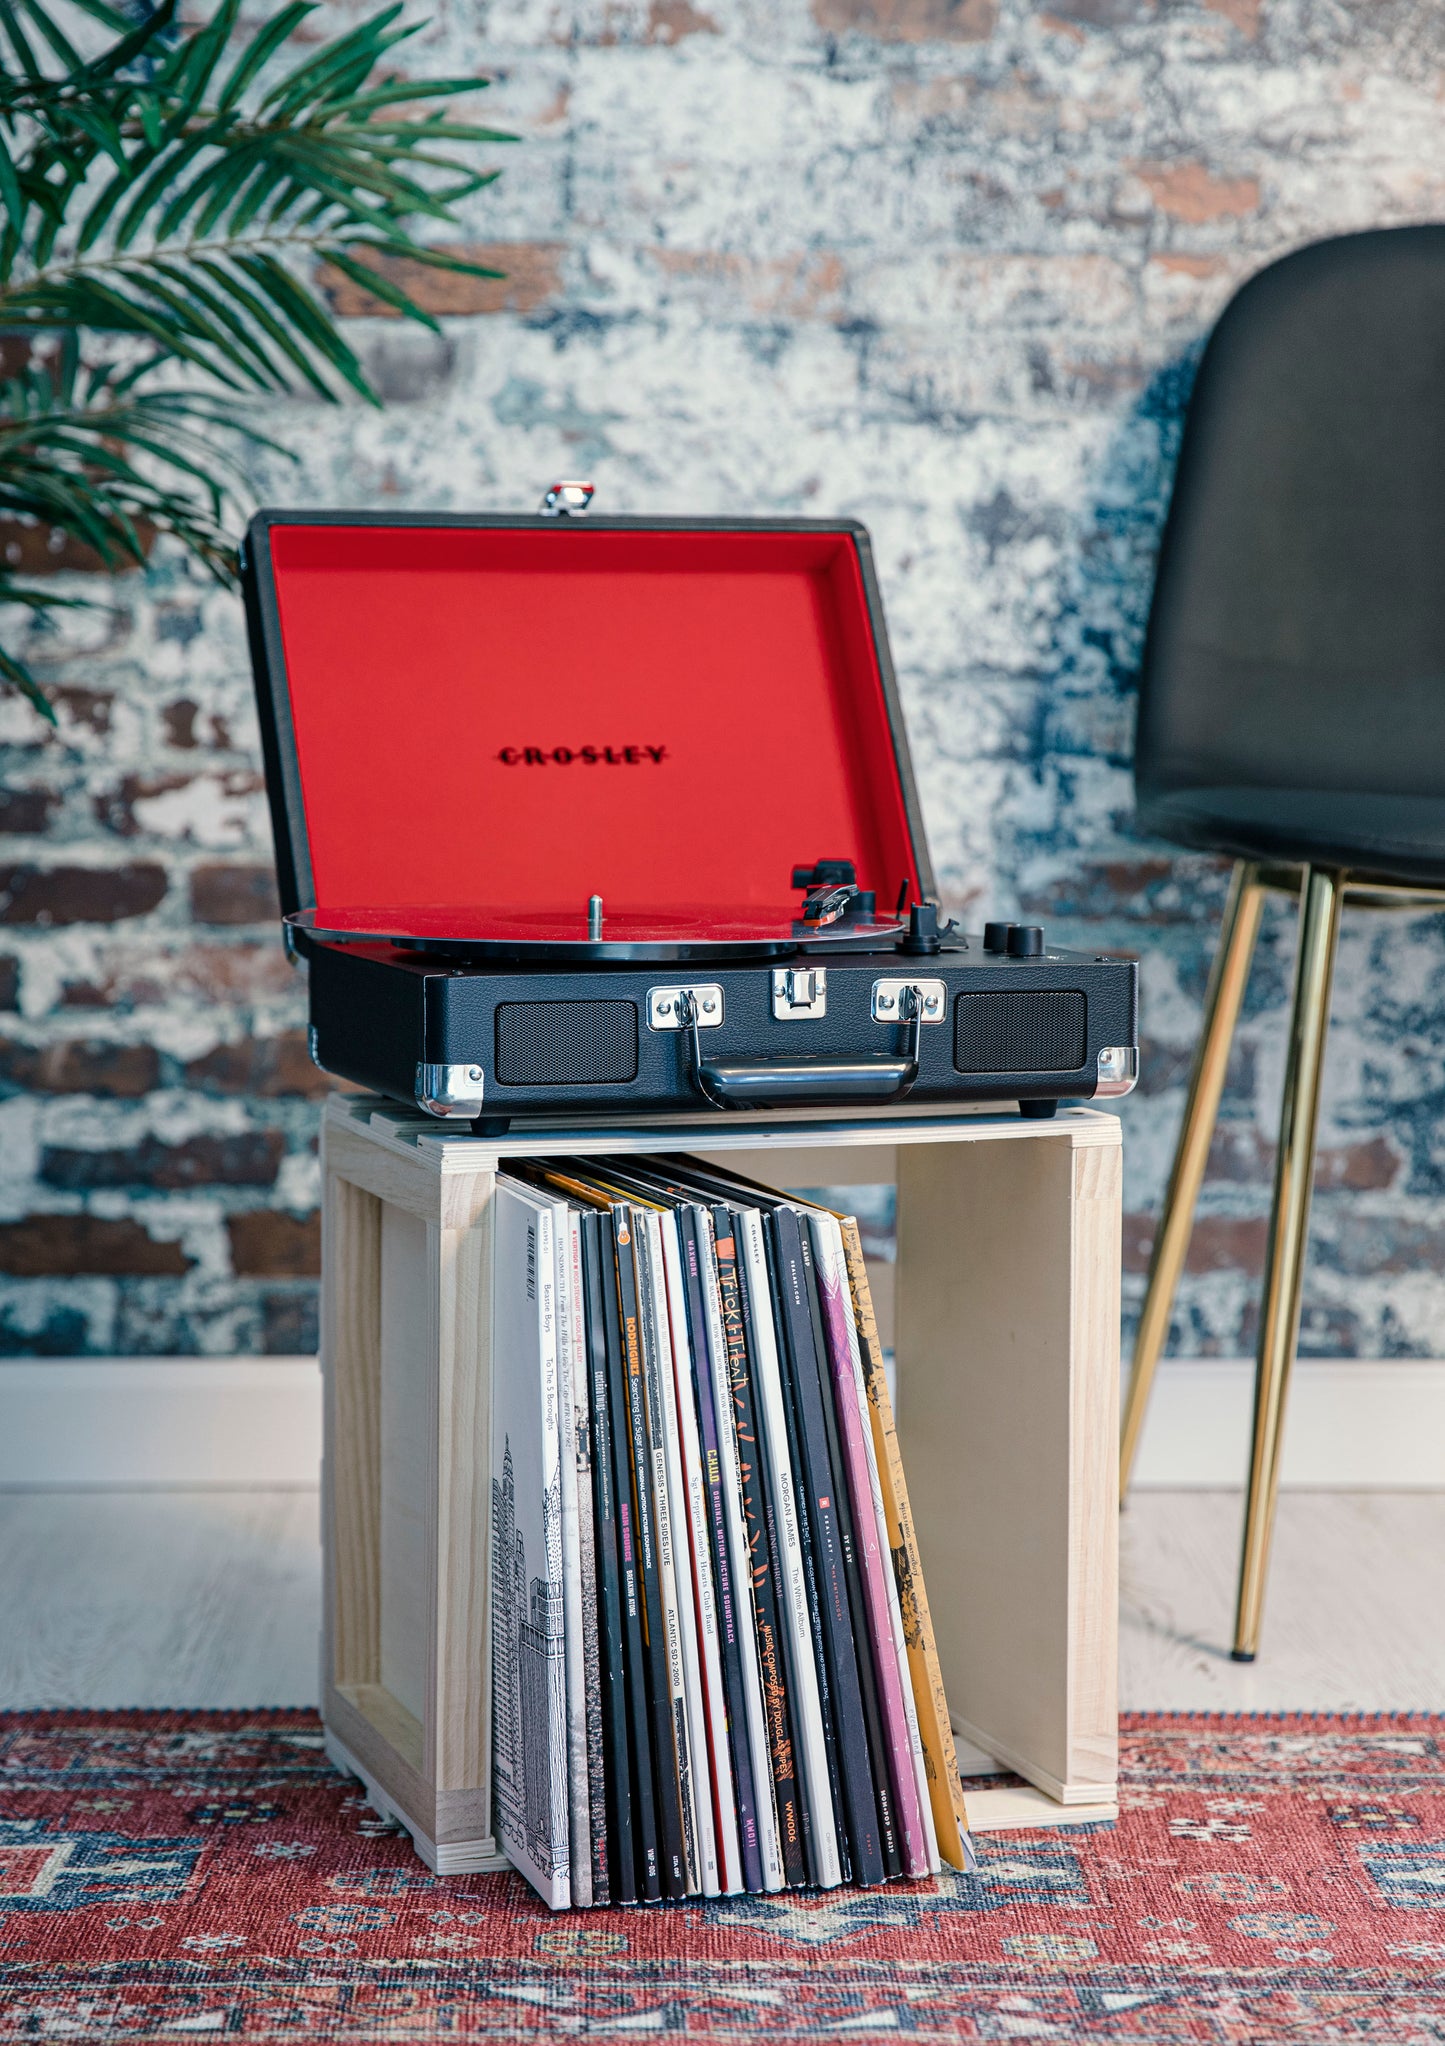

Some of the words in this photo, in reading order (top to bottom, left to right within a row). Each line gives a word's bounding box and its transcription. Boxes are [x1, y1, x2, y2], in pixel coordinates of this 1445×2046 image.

[499, 745, 666, 766] CROSLEY
[751, 1223, 760, 1264] CROSLEY
[802, 1240, 810, 1267] CAAMP
[687, 1239, 697, 1277] WAXWORK
[721, 1267, 740, 1322] Trick
[738, 1266, 747, 1298] NIGHT
[790, 1260, 800, 1305] REALART.COM
[626, 1317, 640, 1377] RODRIGUEZ
[728, 1332, 749, 1385] Treat
[546, 1357, 553, 1367] To
[631, 1378, 641, 1413] Searching
[546, 1393, 554, 1430] Boroughs
[634, 1414, 642, 1426] For
[634, 1426, 644, 1447] Sugar
[637, 1448, 645, 1464] Man
[655, 1452, 665, 1487] GENESIS
[707, 1449, 719, 1485] C.H.U.D.
[712, 1490, 723, 1526] ORIGINAL
[780, 1472, 793, 1516] MORGAN
[621, 1503, 630, 1526] MAIN
[659, 1495, 668, 1523] THREE
[900, 1502, 908, 1520] WELLS
[661, 1523, 670, 1547] SIDES
[696, 1530, 706, 1558] Lonely
[716, 1529, 727, 1557] MOTION
[766, 1505, 779, 1555] DANCING
[786, 1519, 796, 1548] JAMES
[622, 1527, 632, 1562] SOURCE
[644, 1535, 652, 1569] SOUNDTRACK
[663, 1549, 671, 1566] LIVE
[843, 1534, 850, 1544] BY
[847, 1553, 853, 1563] BY
[626, 1570, 635, 1597] BREAKING
[700, 1562, 709, 1588] Hearts
[719, 1560, 730, 1592] PICTURE
[772, 1556, 784, 1600] CHROME
[791, 1567, 801, 1584] The
[628, 1598, 636, 1617] ATOMS
[703, 1592, 712, 1612] Club
[794, 1586, 803, 1610] White
[833, 1582, 842, 1623] ANTHOLOGY
[668, 1609, 677, 1648] ATLANTIC
[705, 1615, 714, 1635] Band
[722, 1595, 736, 1644] SOUNDTRACK
[797, 1612, 807, 1639] Album
[763, 1625, 774, 1650] MUSIC
[671, 1650, 678, 1660] SD
[672, 1662, 680, 1687] 2-2000
[766, 1652, 780, 1697] COMPOSED
[772, 1699, 781, 1710] BY
[773, 1712, 786, 1751] DOUGLAS
[908, 1709, 917, 1730] even
[912, 1735, 922, 1756] hand
[778, 1752, 788, 1775] PIPES
[746, 1818, 755, 1847] WW011
[784, 1800, 796, 1843] WW006
[886, 1830, 895, 1854] MP419
